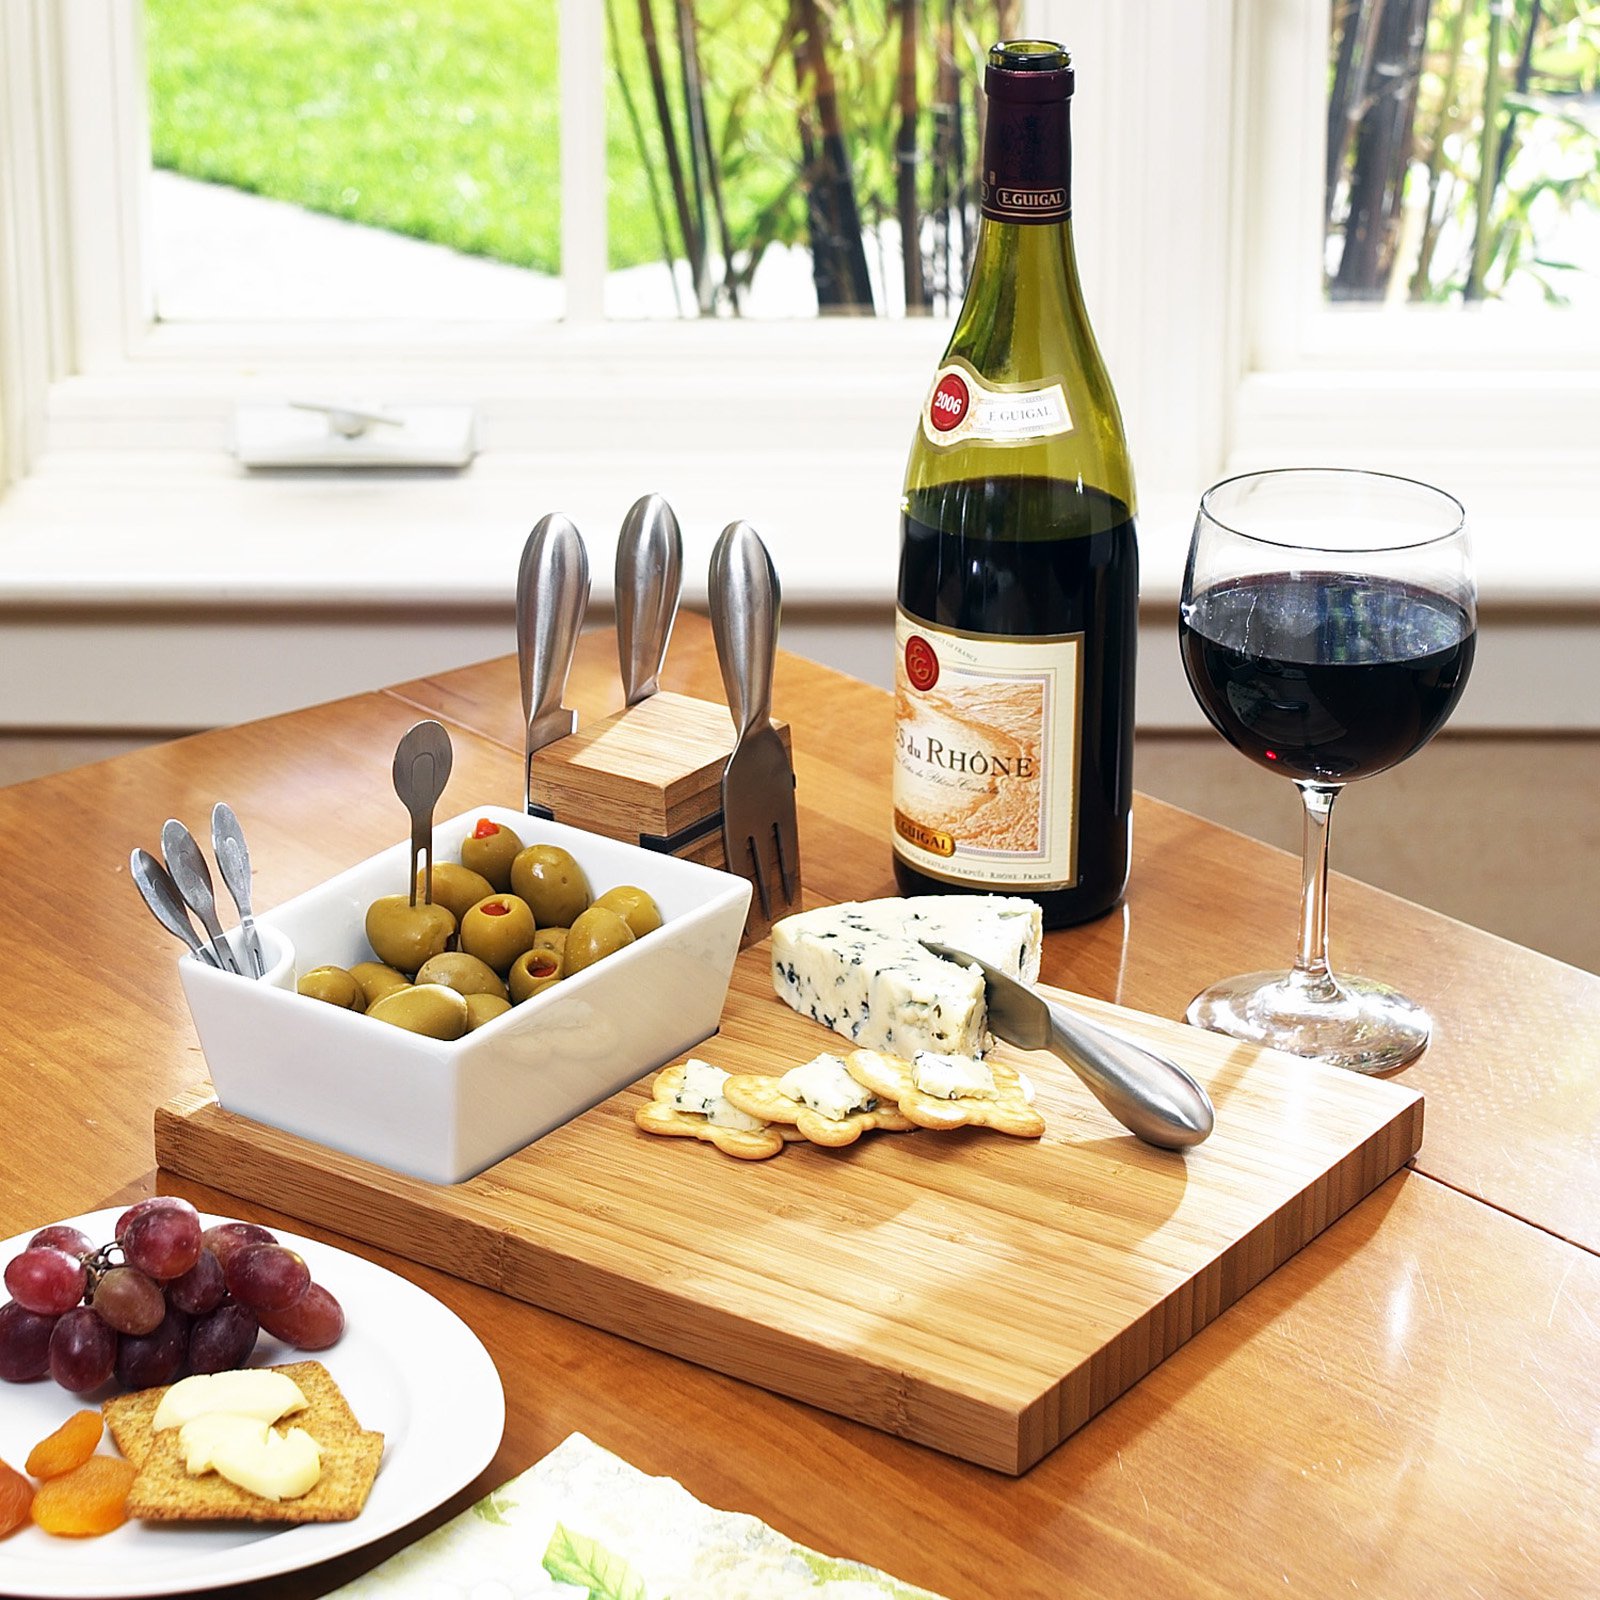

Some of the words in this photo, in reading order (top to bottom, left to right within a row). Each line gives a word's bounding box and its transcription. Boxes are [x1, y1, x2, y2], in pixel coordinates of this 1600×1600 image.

[934, 390, 962, 415] 2006
[955, 646, 978, 662] FRANCE
[907, 735, 921, 759] du
[927, 737, 1033, 777] RHÔNE
[1023, 872, 1052, 880] FRANCE
